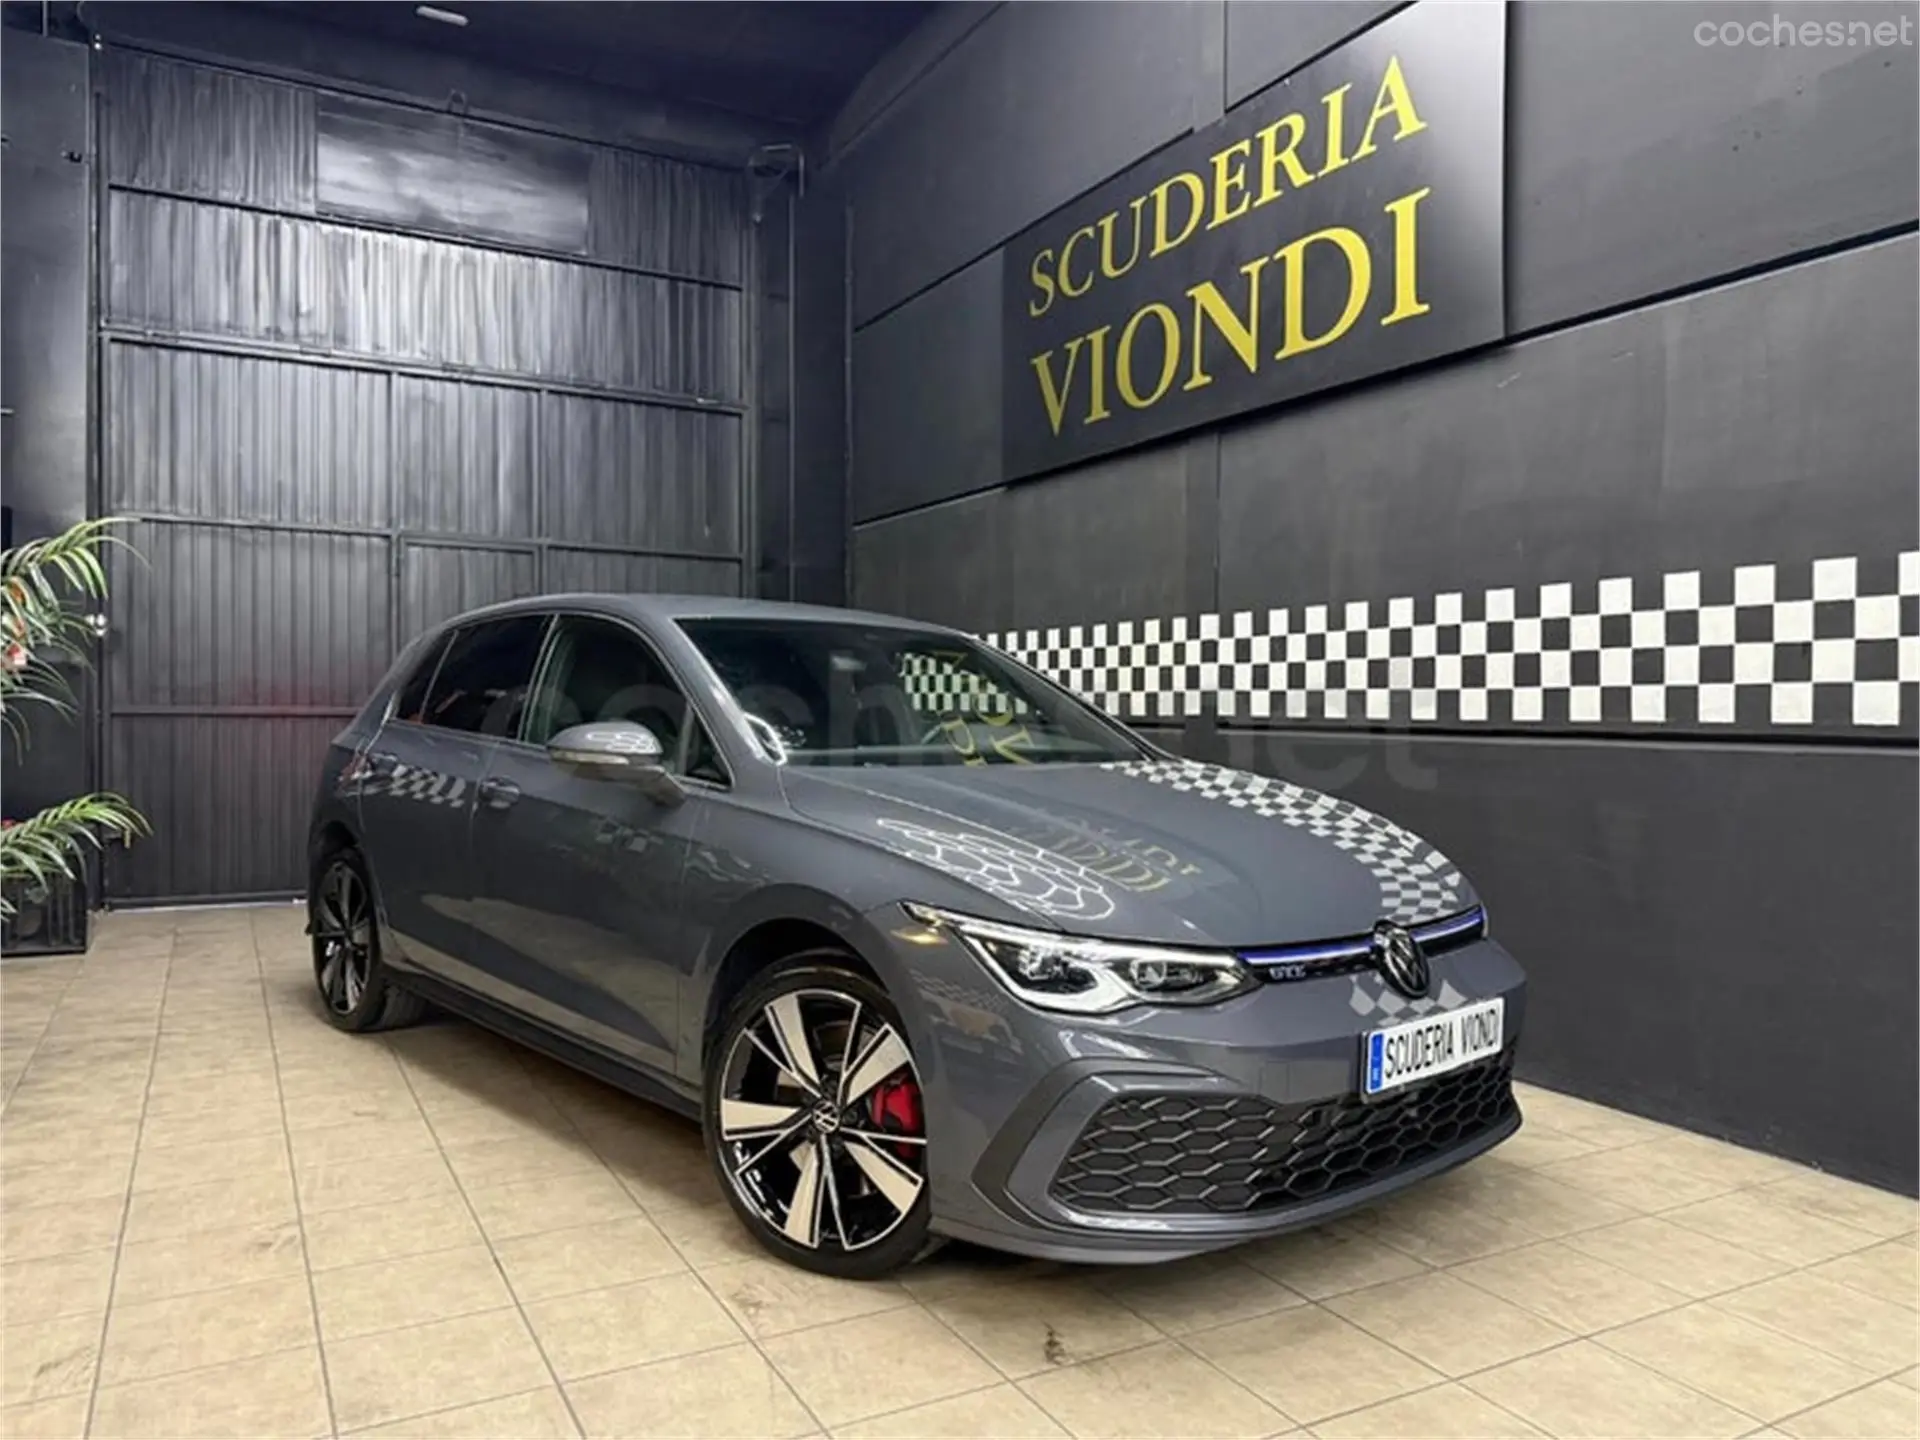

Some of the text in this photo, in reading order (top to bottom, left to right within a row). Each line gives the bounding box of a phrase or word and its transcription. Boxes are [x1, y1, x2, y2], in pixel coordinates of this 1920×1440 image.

[1029, 55, 1428, 317] SCUDERIA
[1030, 187, 1431, 437] VIONDI
[1384, 1005, 1499, 1079] SCUDERIA VIONDI
